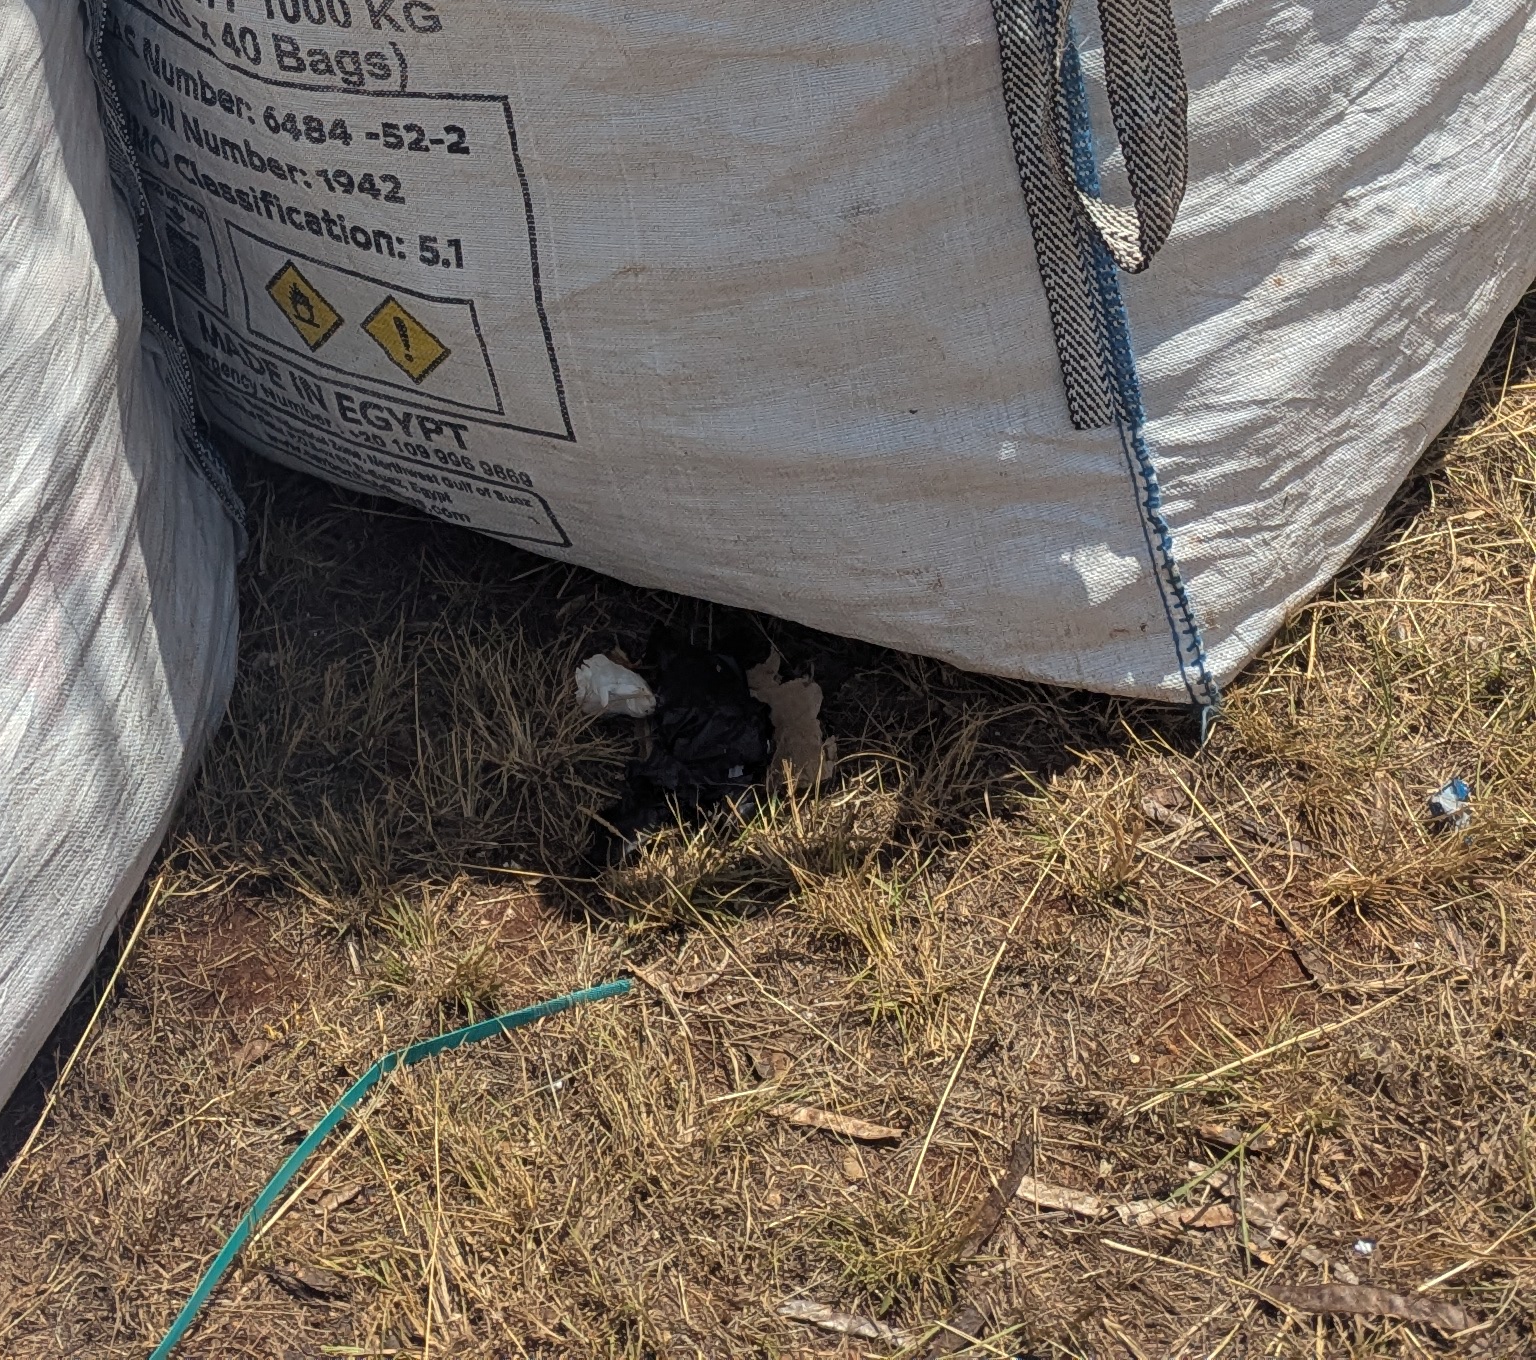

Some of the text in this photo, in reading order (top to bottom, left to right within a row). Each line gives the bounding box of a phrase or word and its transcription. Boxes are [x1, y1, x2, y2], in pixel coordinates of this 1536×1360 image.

[143, 37, 256, 126] Number:
[263, 106, 353, 147] 6484
[221, 22, 262, 67] 40
[272, 34, 408, 94] Bags)
[141, 79, 406, 205] UN Number: 1942
[173, 154, 407, 262] Classification:
[418, 237, 464, 270] 5.1
[196, 312, 282, 398] MADE
[289, 362, 329, 414] IN
[337, 396, 470, 451] EGYPT
[392, 436, 429, 463] 109
[440, 472, 473, 496] Gulf
[475, 484, 493, 499] of
